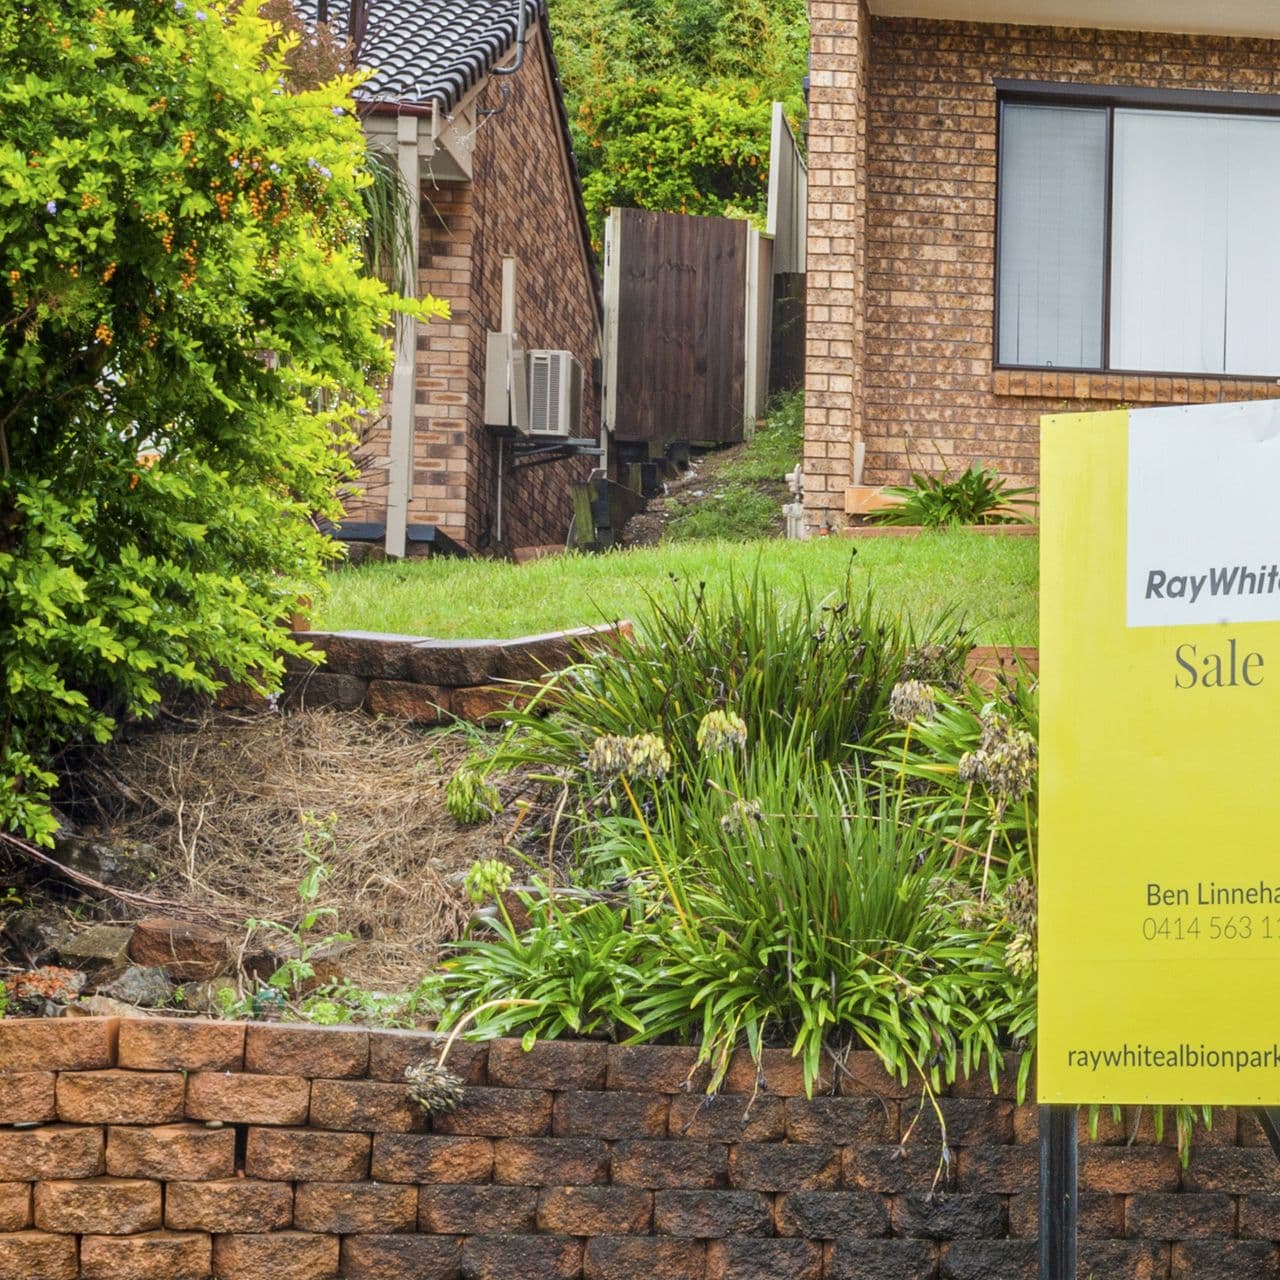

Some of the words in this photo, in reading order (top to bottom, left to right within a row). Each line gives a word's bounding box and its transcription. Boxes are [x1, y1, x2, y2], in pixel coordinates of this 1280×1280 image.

[1175, 638, 1265, 689] Sale
[1147, 883, 1189, 906] Ben
[1142, 916, 1201, 941] 0414
[1209, 915, 1252, 940] 563
